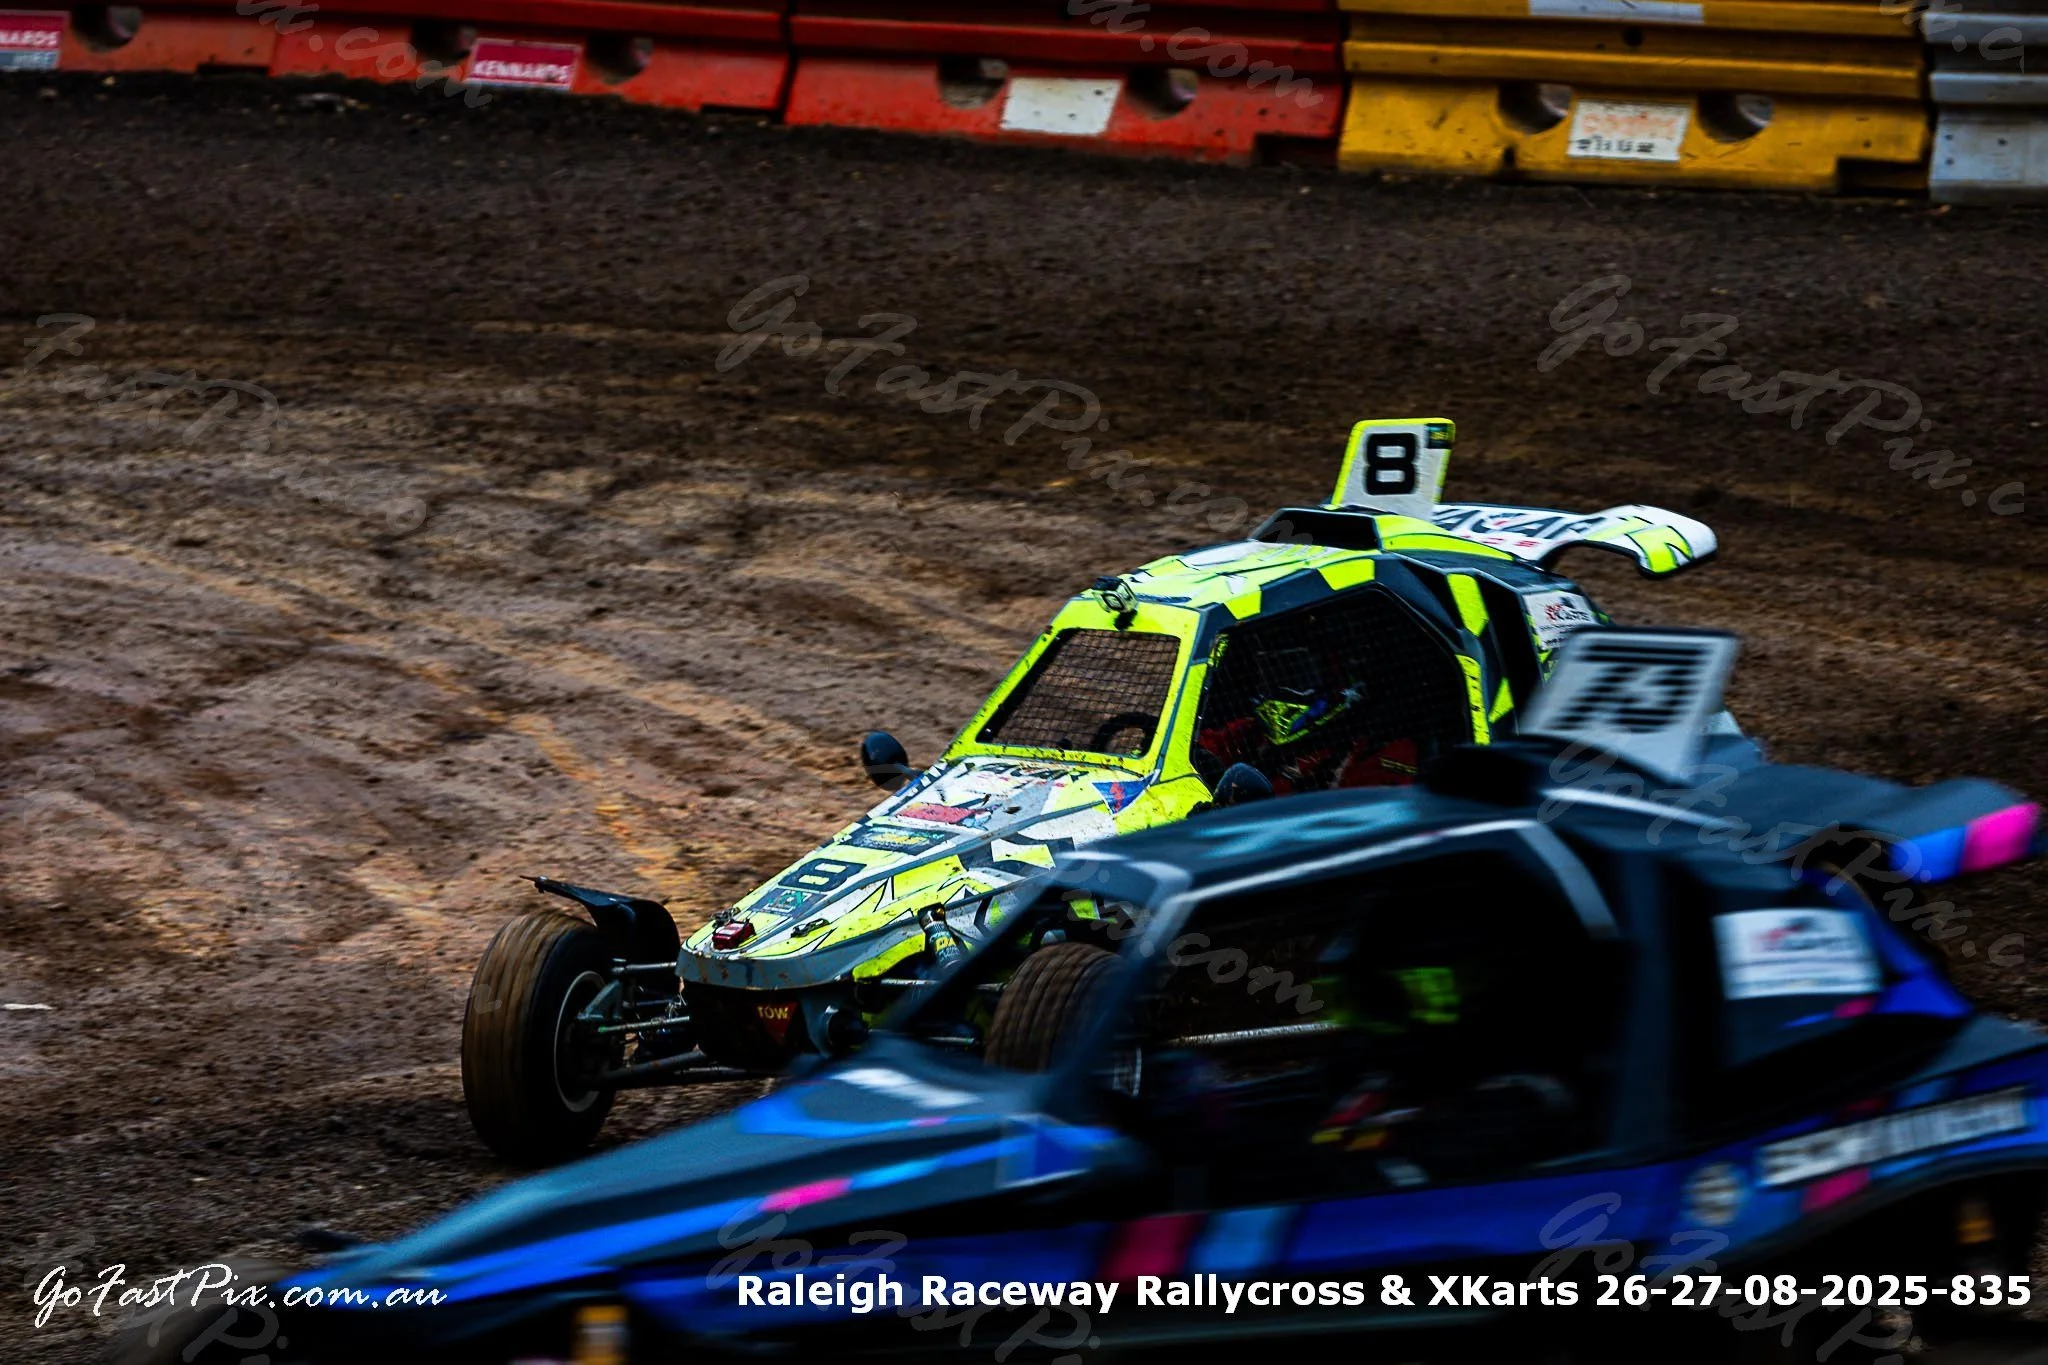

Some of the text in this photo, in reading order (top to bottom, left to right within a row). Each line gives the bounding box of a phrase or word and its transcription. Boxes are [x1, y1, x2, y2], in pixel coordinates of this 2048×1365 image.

[1366, 433, 1418, 496] 8
[777, 857, 868, 893] 8
[757, 1005, 789, 1020] TOW
